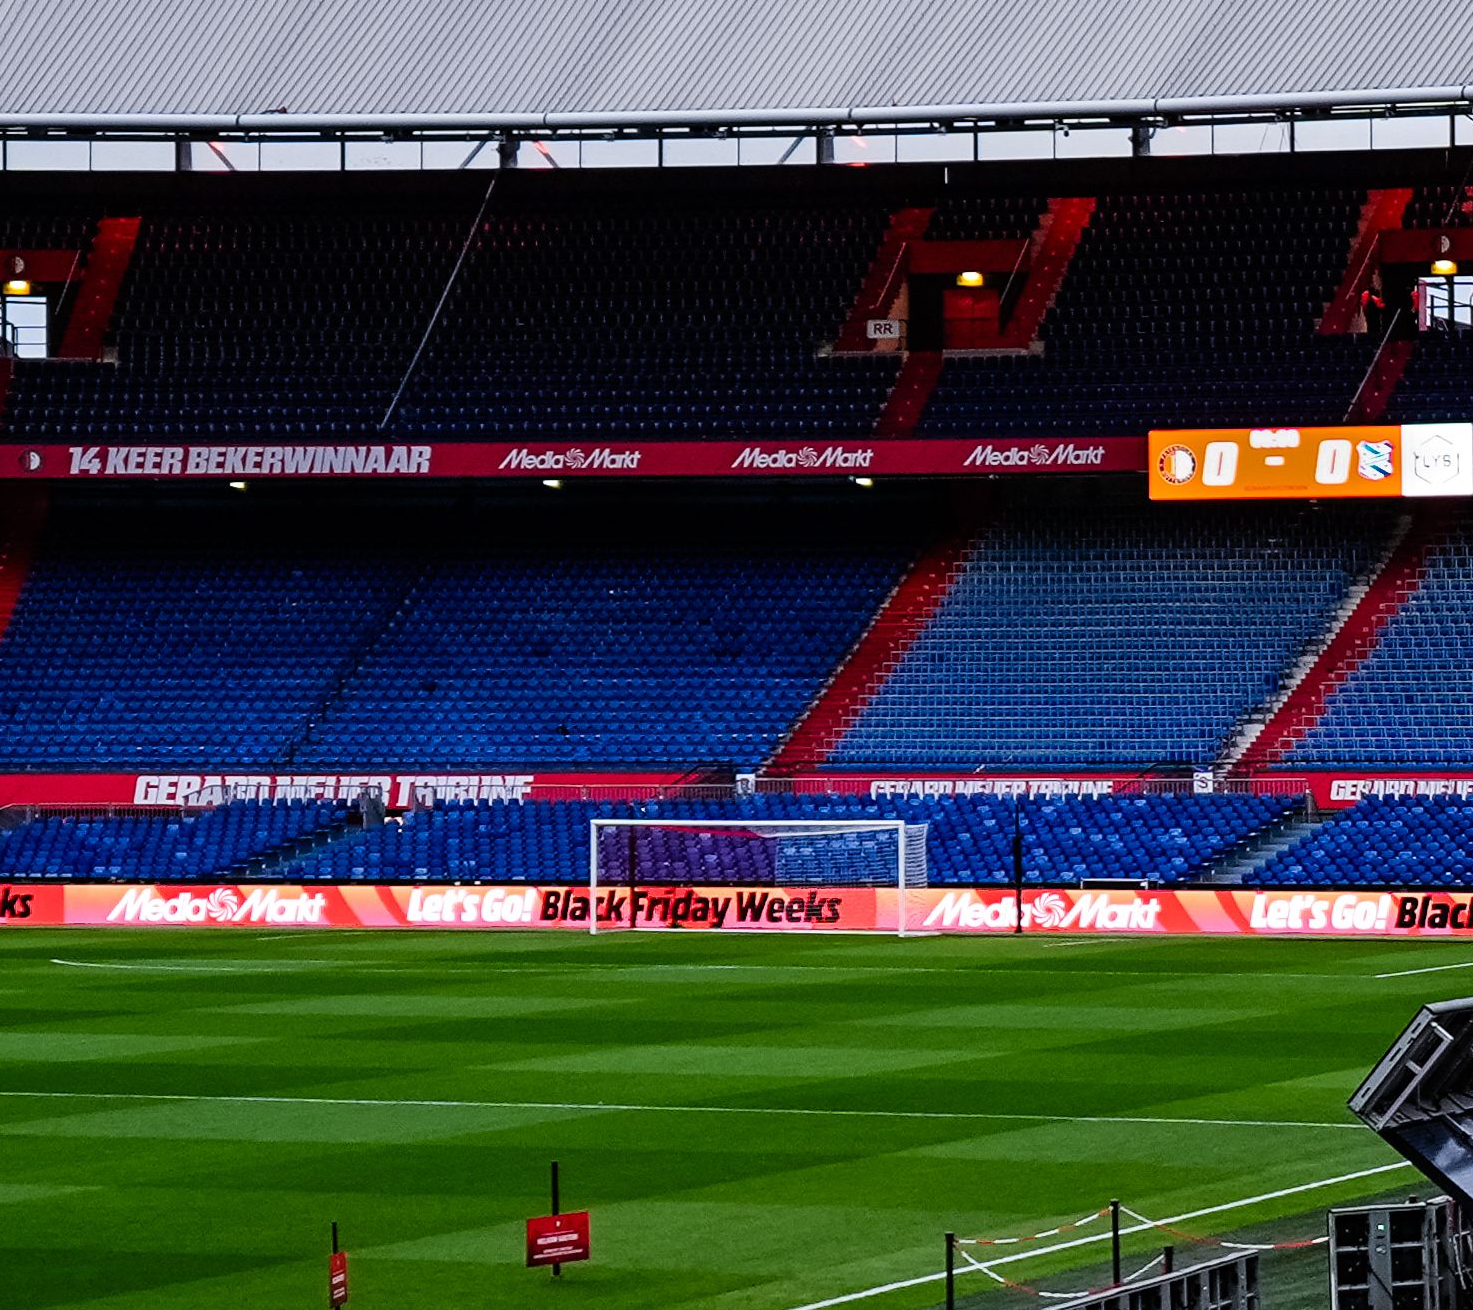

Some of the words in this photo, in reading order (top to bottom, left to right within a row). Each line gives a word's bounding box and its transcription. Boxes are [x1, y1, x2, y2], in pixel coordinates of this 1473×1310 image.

[873, 323, 893, 335] RR
[69, 447, 101, 475] 14
[106, 447, 180, 475] KEER
[184, 446, 432, 475] BEKERWINNAAR
[498, 448, 642, 471] MediaMarkt
[731, 446, 874, 470] MediaMarkt
[962, 444, 1105, 466] MediaMarkt
[1202, 441, 1239, 486] 0
[1315, 439, 1353, 485] 0
[133, 775, 272, 807] GERARD
[106, 886, 325, 923] MediaMarkt
[406, 888, 477, 921] Let's
[480, 888, 535, 921] Go!
[540, 889, 622, 922] Black
[630, 890, 730, 927] Friday
[737, 890, 842, 923] Weeks
[1250, 891, 1330, 929] Let's
[1333, 891, 1392, 929] Go!
